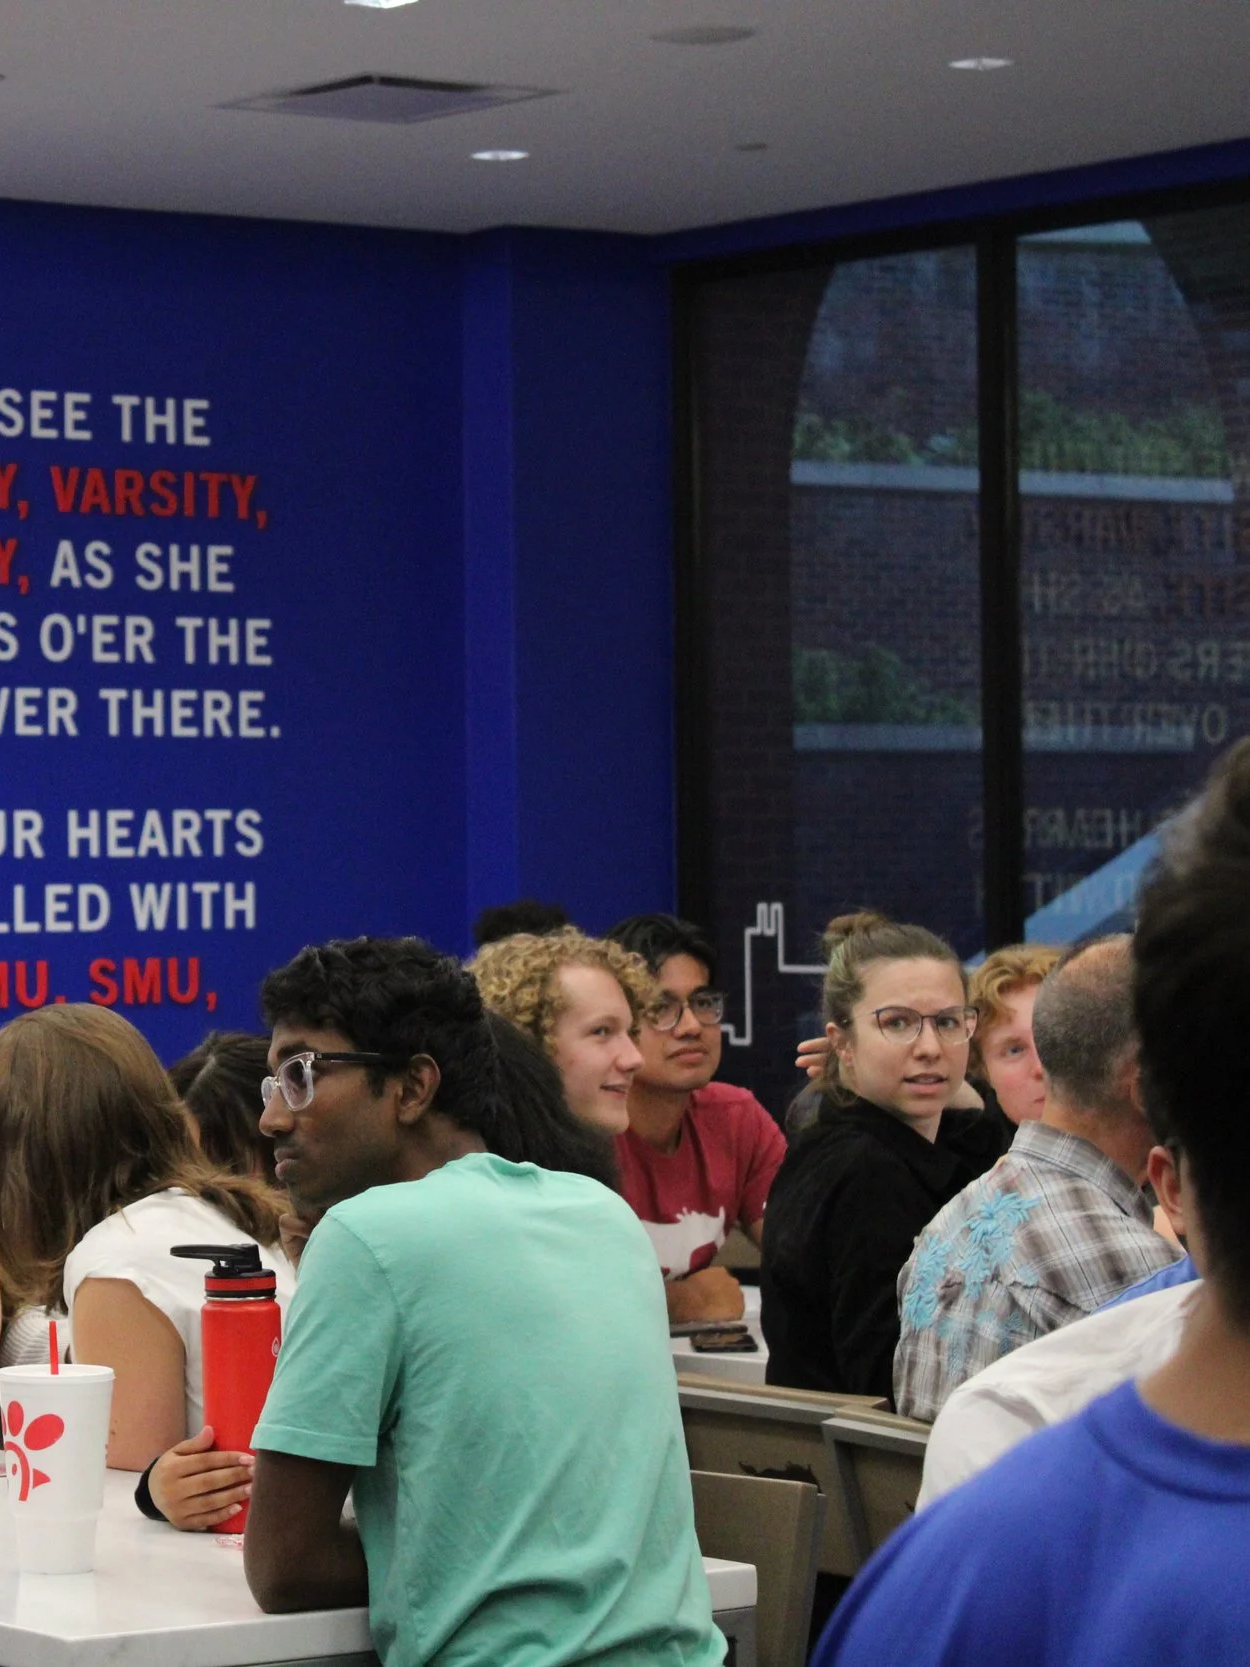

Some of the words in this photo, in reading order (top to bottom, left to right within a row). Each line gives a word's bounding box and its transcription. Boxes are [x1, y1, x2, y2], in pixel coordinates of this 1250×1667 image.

[112, 395, 211, 446] THE
[50, 466, 268, 530] VARSITY,
[50, 539, 113, 589] AS
[135, 542, 235, 593] SHE
[39, 612, 155, 664] O'ER
[175, 616, 272, 666] THE
[99, 688, 281, 738] THERE.
[67, 808, 264, 858] HEARTS
[129, 881, 256, 931] WITH
[88, 956, 218, 1012] SMU,
